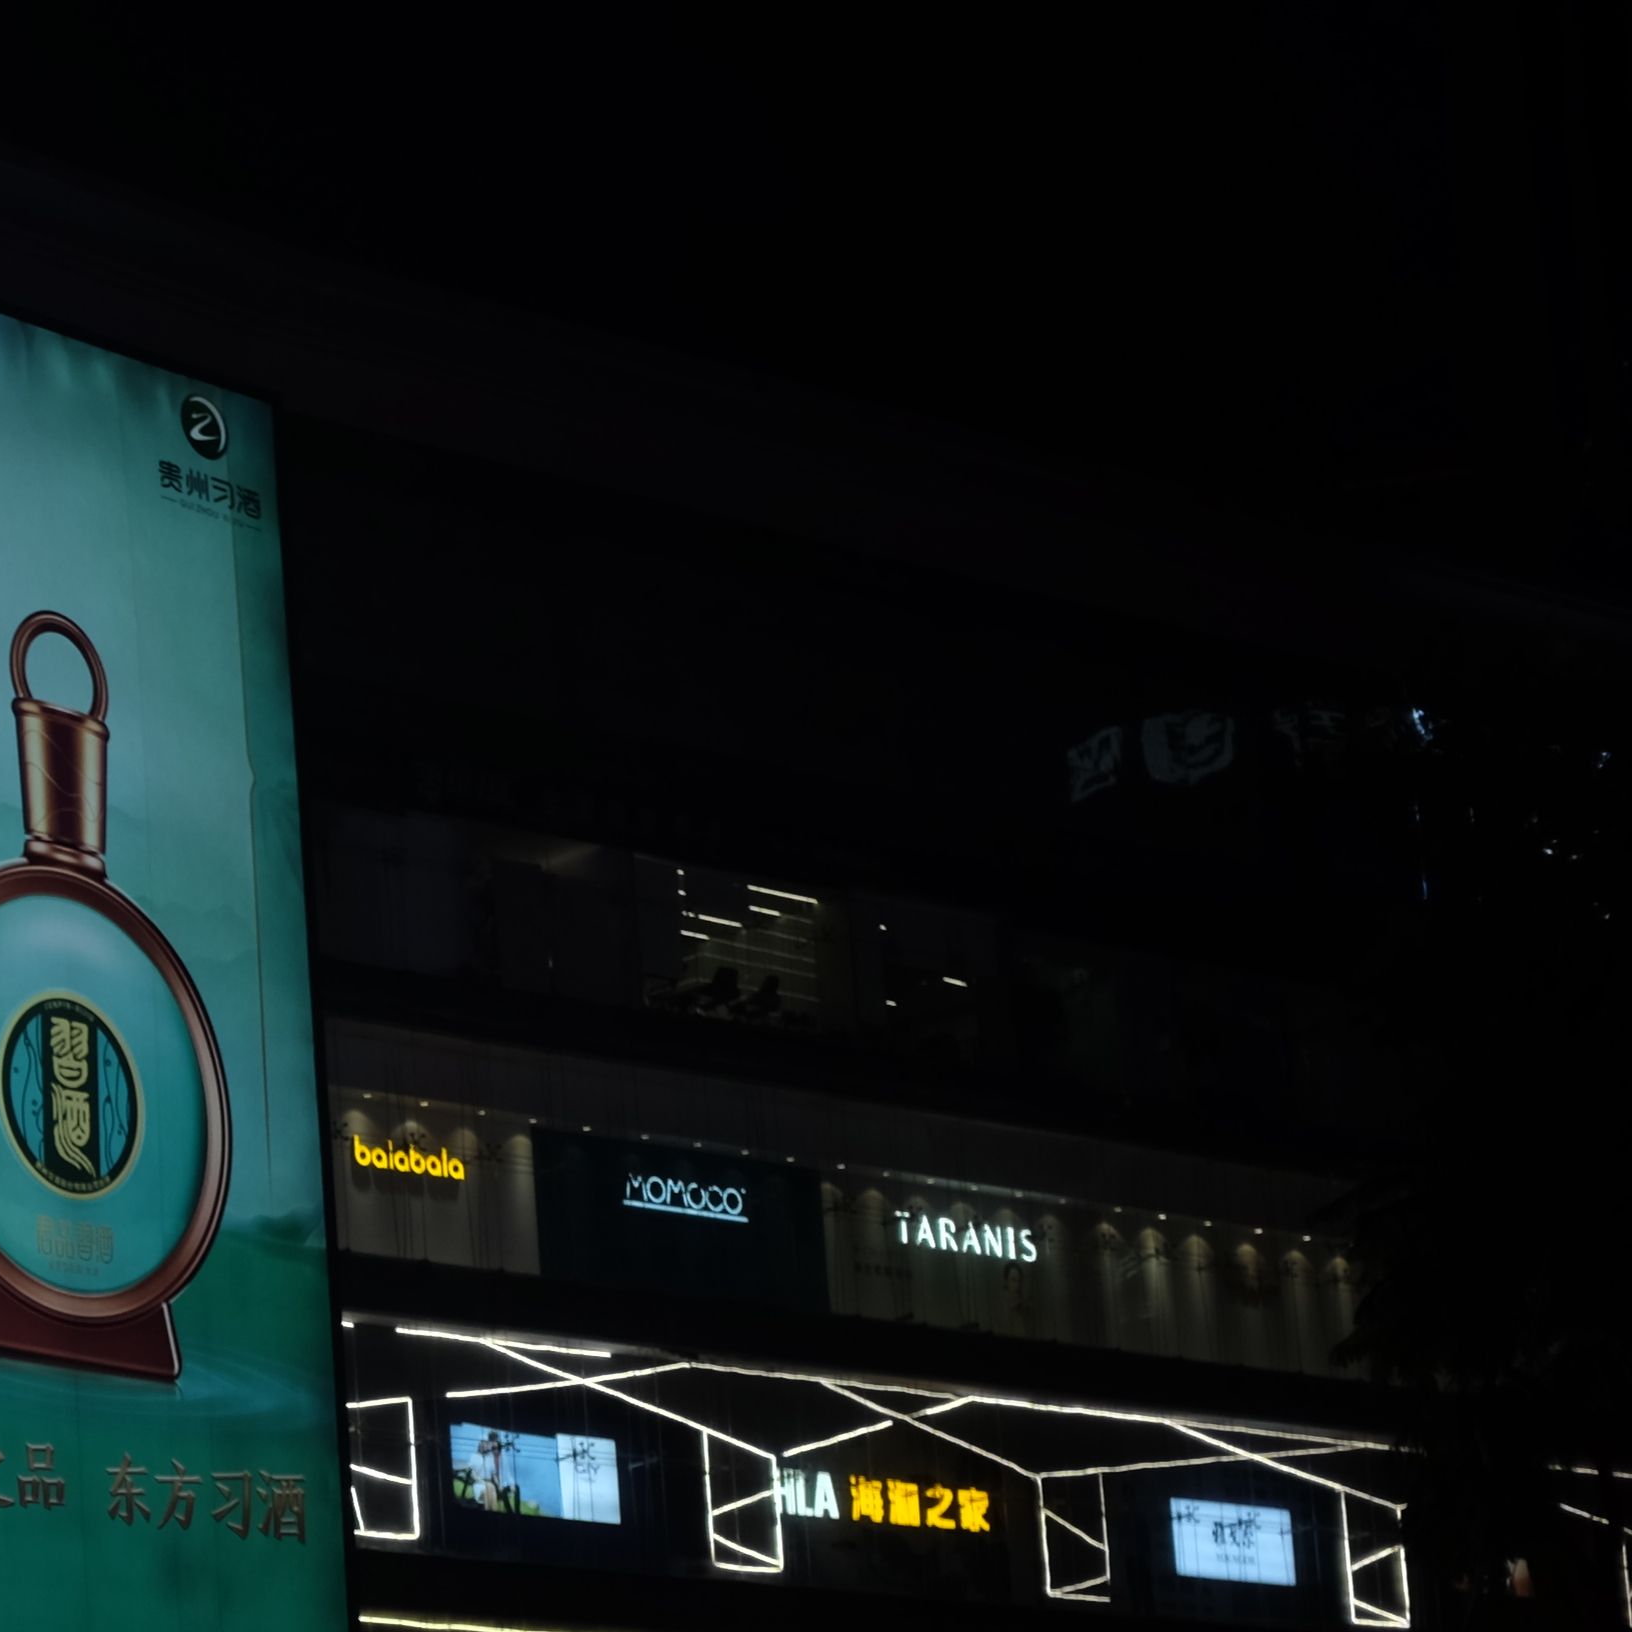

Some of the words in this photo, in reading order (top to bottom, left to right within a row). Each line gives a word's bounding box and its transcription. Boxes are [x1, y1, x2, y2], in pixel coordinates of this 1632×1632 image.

[893, 1210, 1037, 1263] TARANIS
[105, 1450, 309, 1543] 东方习酒
[849, 1474, 991, 1532] 海澜之家
